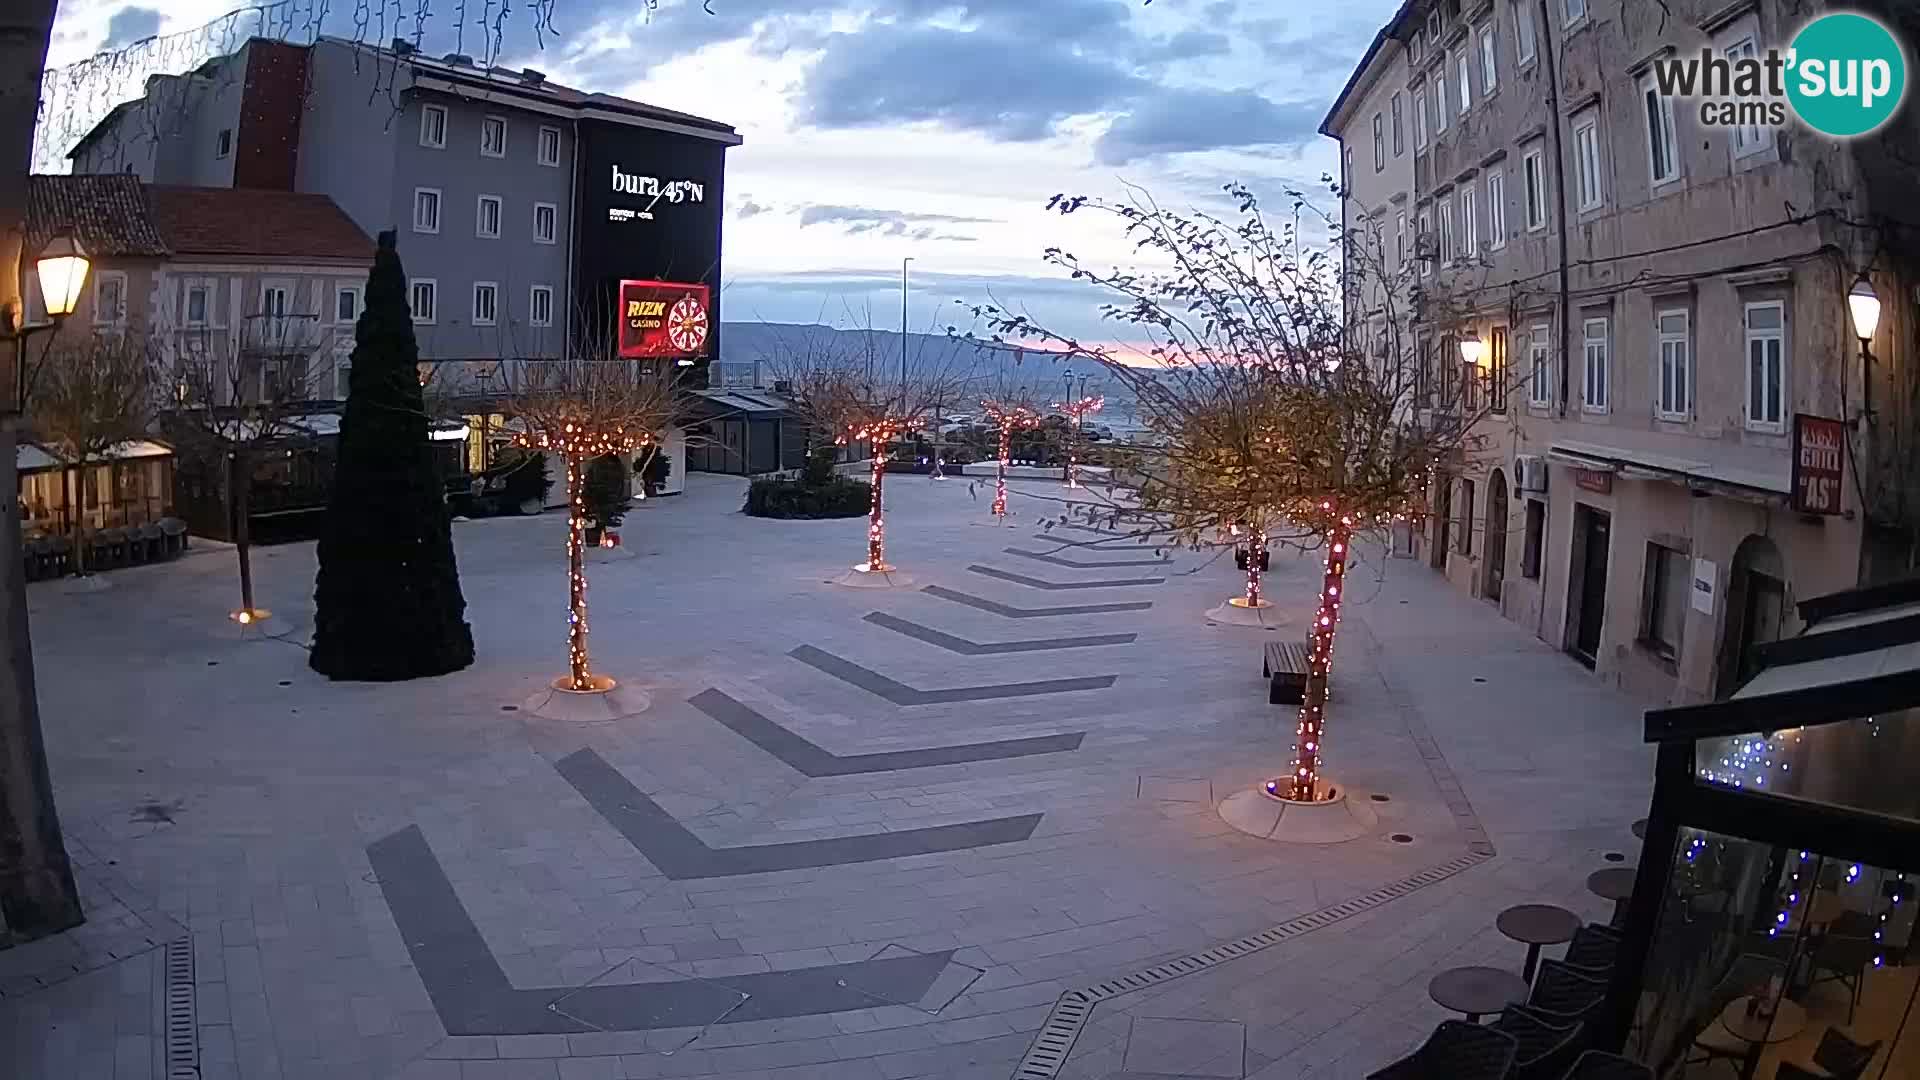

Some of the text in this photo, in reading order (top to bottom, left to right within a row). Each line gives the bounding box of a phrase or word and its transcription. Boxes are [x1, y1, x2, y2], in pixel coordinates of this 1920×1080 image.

[627, 300, 666, 317] RIZK
[631, 319, 661, 329] CASINO
[1800, 447, 1841, 471] GRILL
